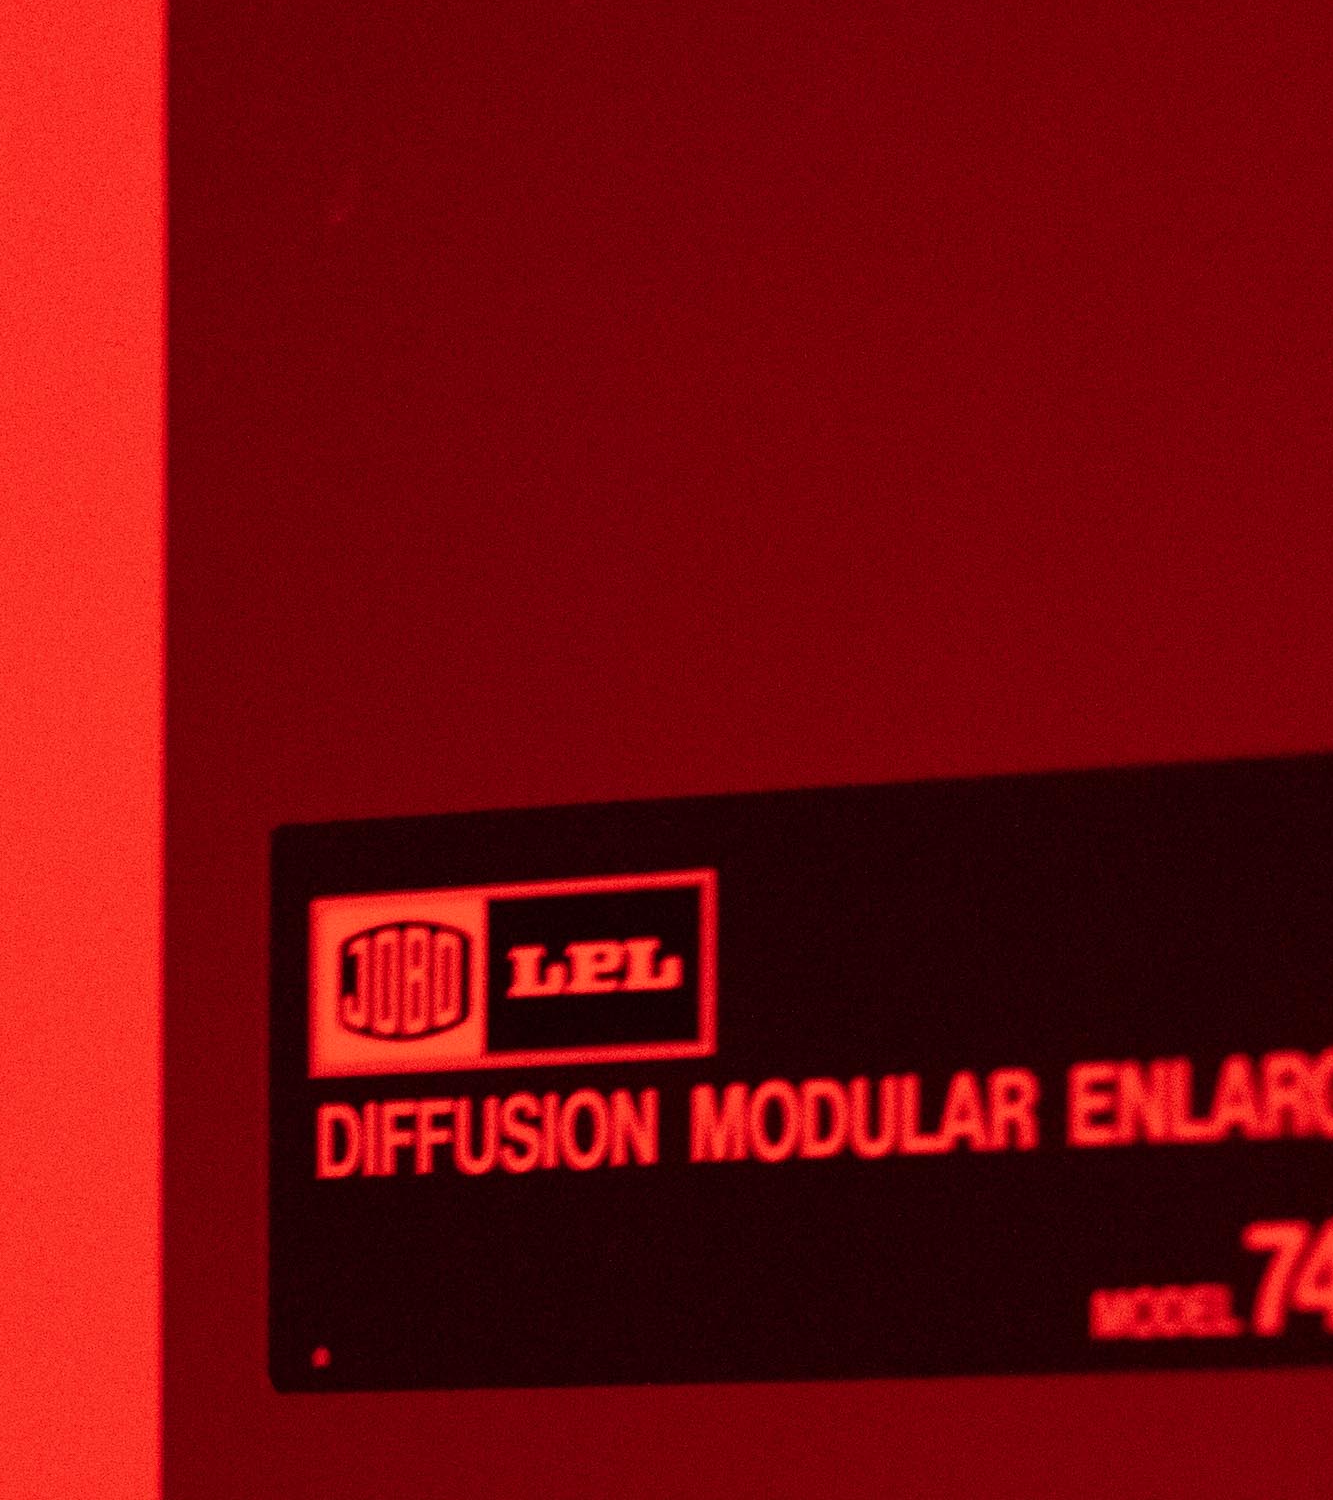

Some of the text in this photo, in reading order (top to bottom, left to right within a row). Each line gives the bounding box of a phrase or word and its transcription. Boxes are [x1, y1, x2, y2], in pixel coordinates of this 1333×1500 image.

[341, 925, 466, 1036] JOBO
[506, 936, 684, 999] LPL
[315, 1087, 660, 1180] DIFFUSION
[688, 1066, 1041, 1164] MODULAR
[1089, 1282, 1246, 1340] MODEL
